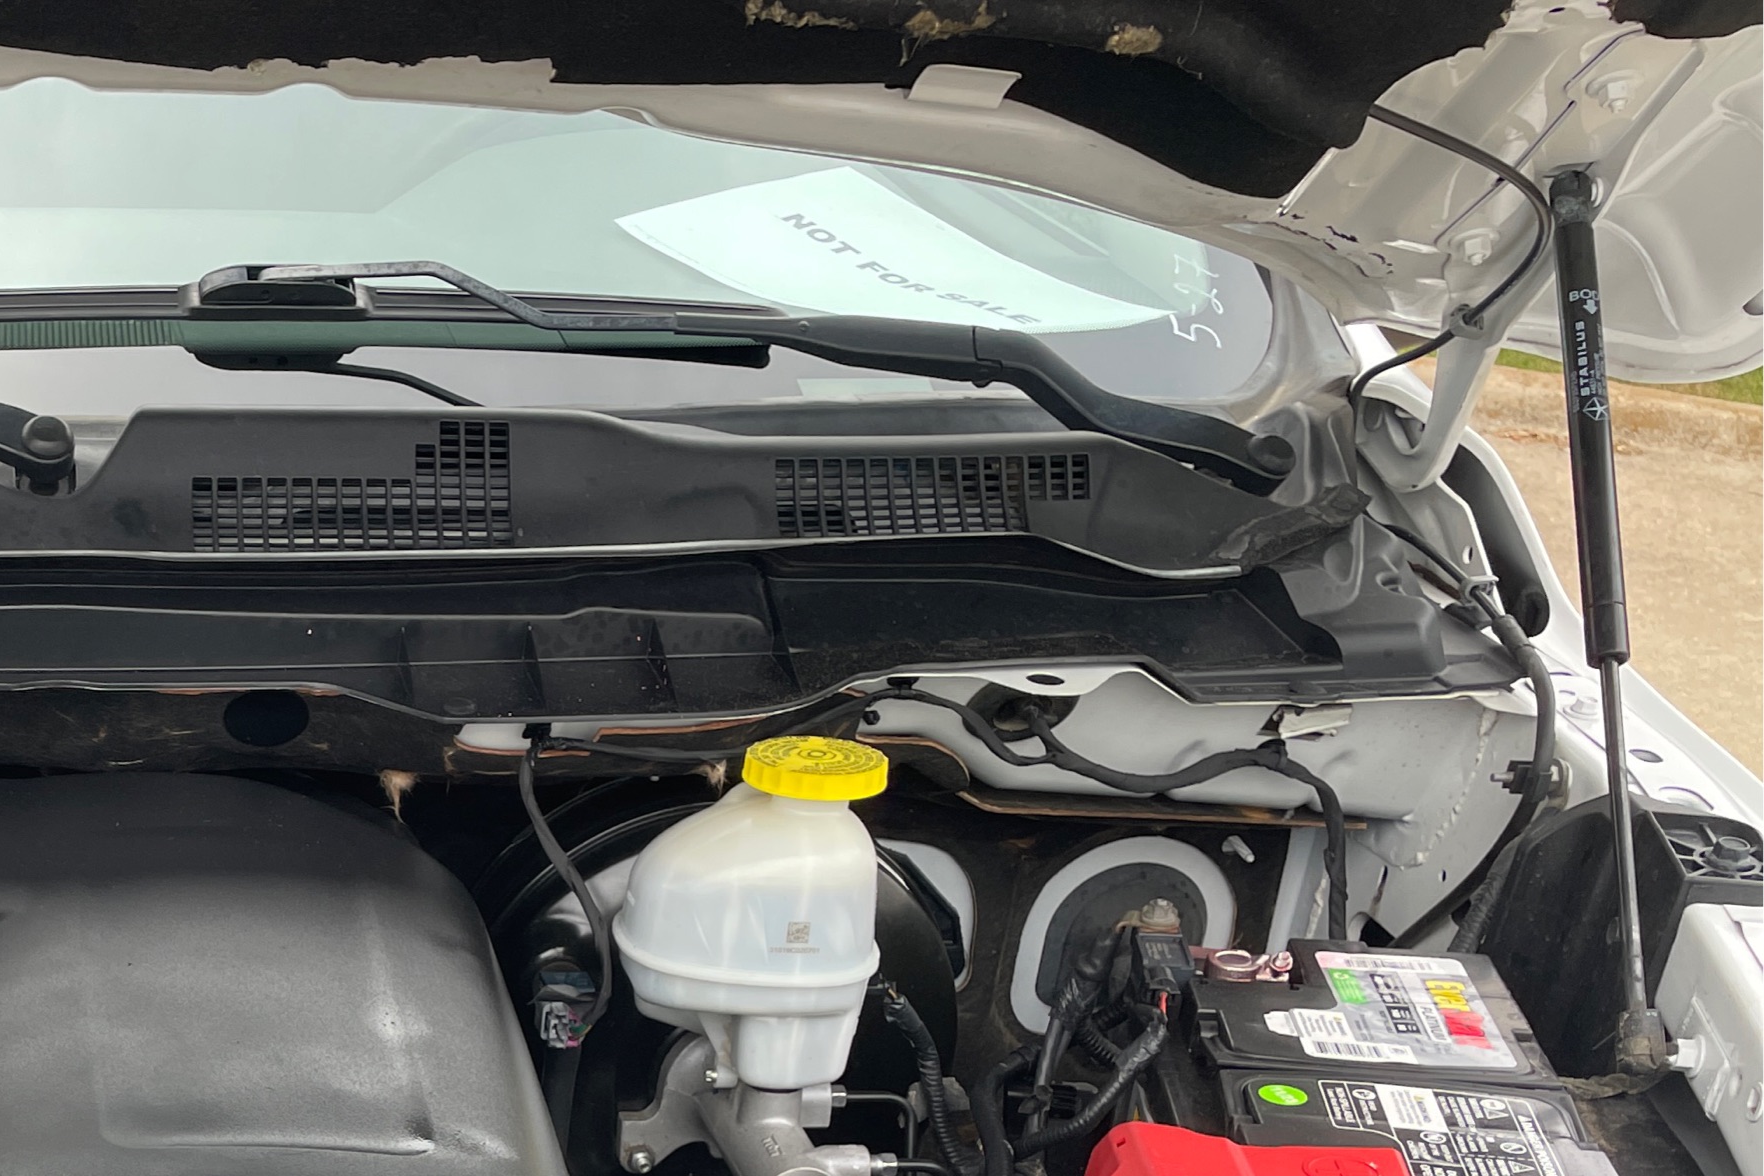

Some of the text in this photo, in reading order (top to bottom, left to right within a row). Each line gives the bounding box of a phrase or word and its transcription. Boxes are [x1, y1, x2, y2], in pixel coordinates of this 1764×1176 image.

[781, 213, 1042, 325] NOT FOR SALE
[1575, 320, 1591, 397] STABILUS
